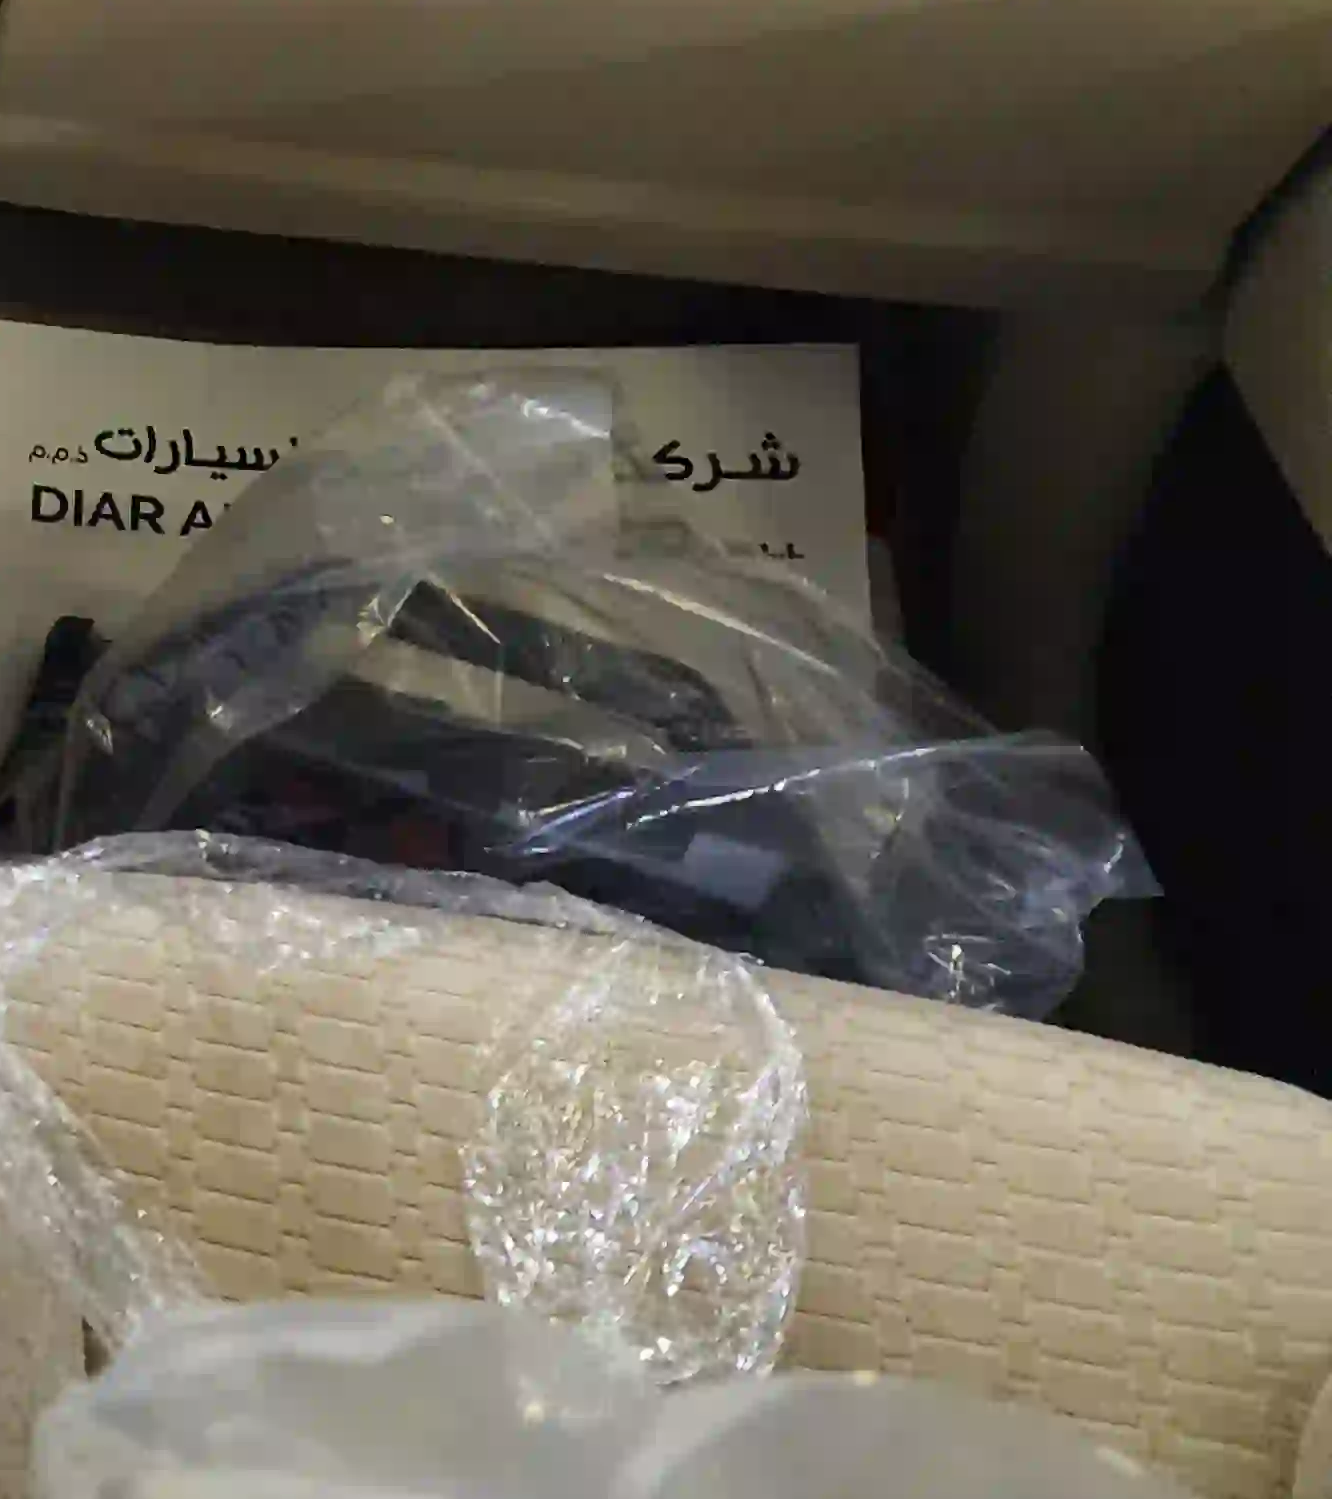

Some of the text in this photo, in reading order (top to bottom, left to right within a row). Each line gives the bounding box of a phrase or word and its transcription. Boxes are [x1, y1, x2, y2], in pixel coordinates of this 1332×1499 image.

[94, 424, 299, 481] سيارات
[648, 431, 800, 492] شرك
[30, 482, 166, 536] DIAR
